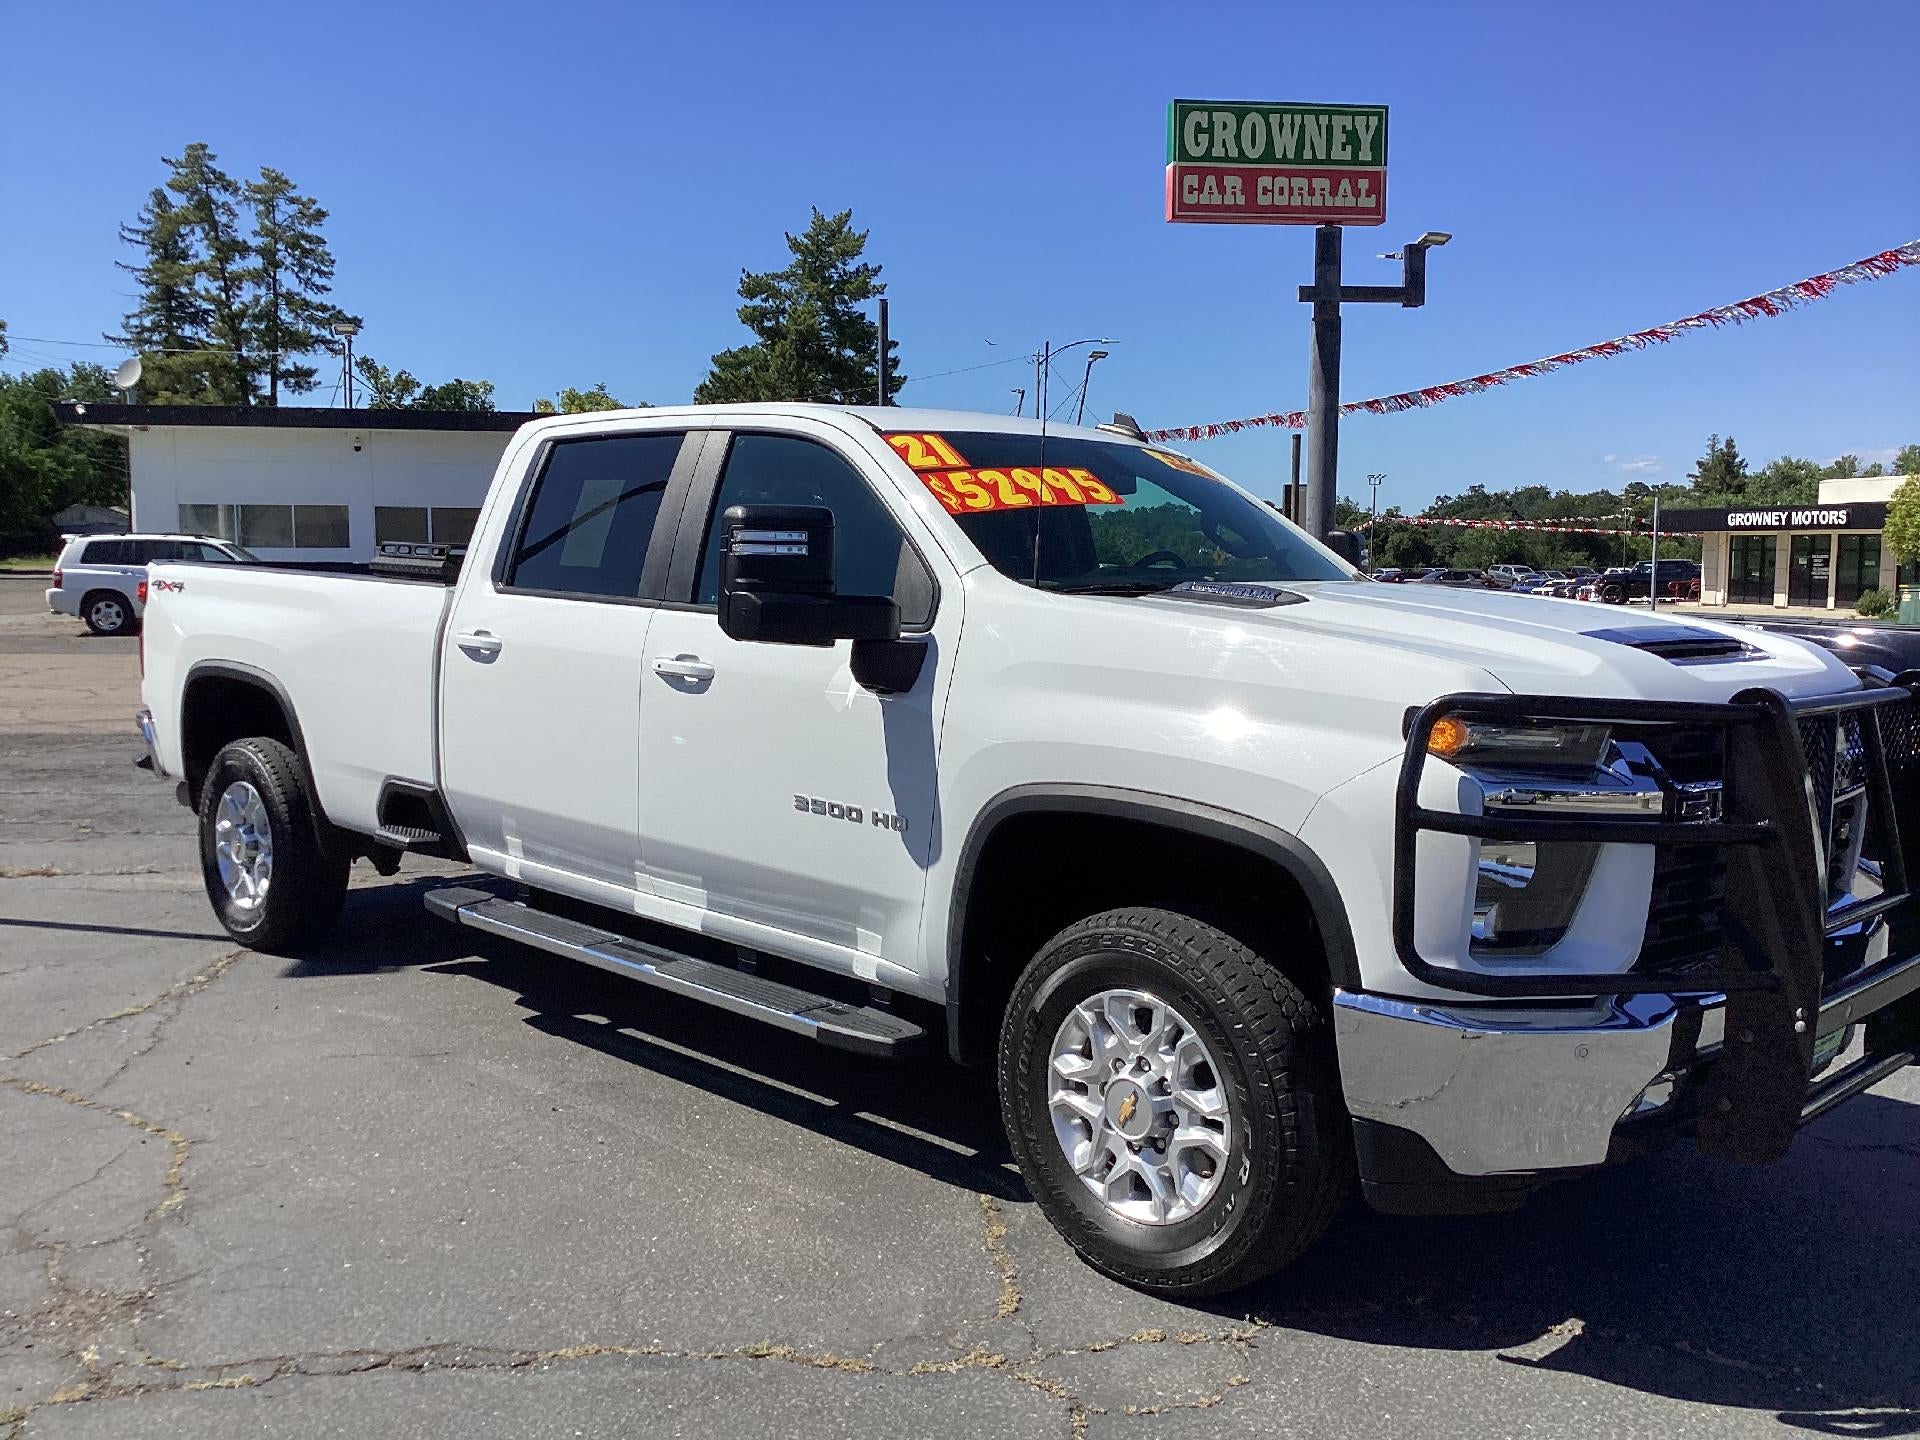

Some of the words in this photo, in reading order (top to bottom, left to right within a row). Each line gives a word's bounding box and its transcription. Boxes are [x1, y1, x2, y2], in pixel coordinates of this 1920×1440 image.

[1183, 110, 1379, 161] GROWNEY
[1182, 174, 1246, 205] CAR
[1257, 175, 1377, 208] CORRAL
[888, 434, 963, 467] 21
[928, 468, 1120, 511] $52995
[1727, 511, 1789, 527] GROWNEY
[1791, 509, 1847, 526] MOTORS
[793, 794, 863, 824] 3500
[871, 810, 908, 832] HD
